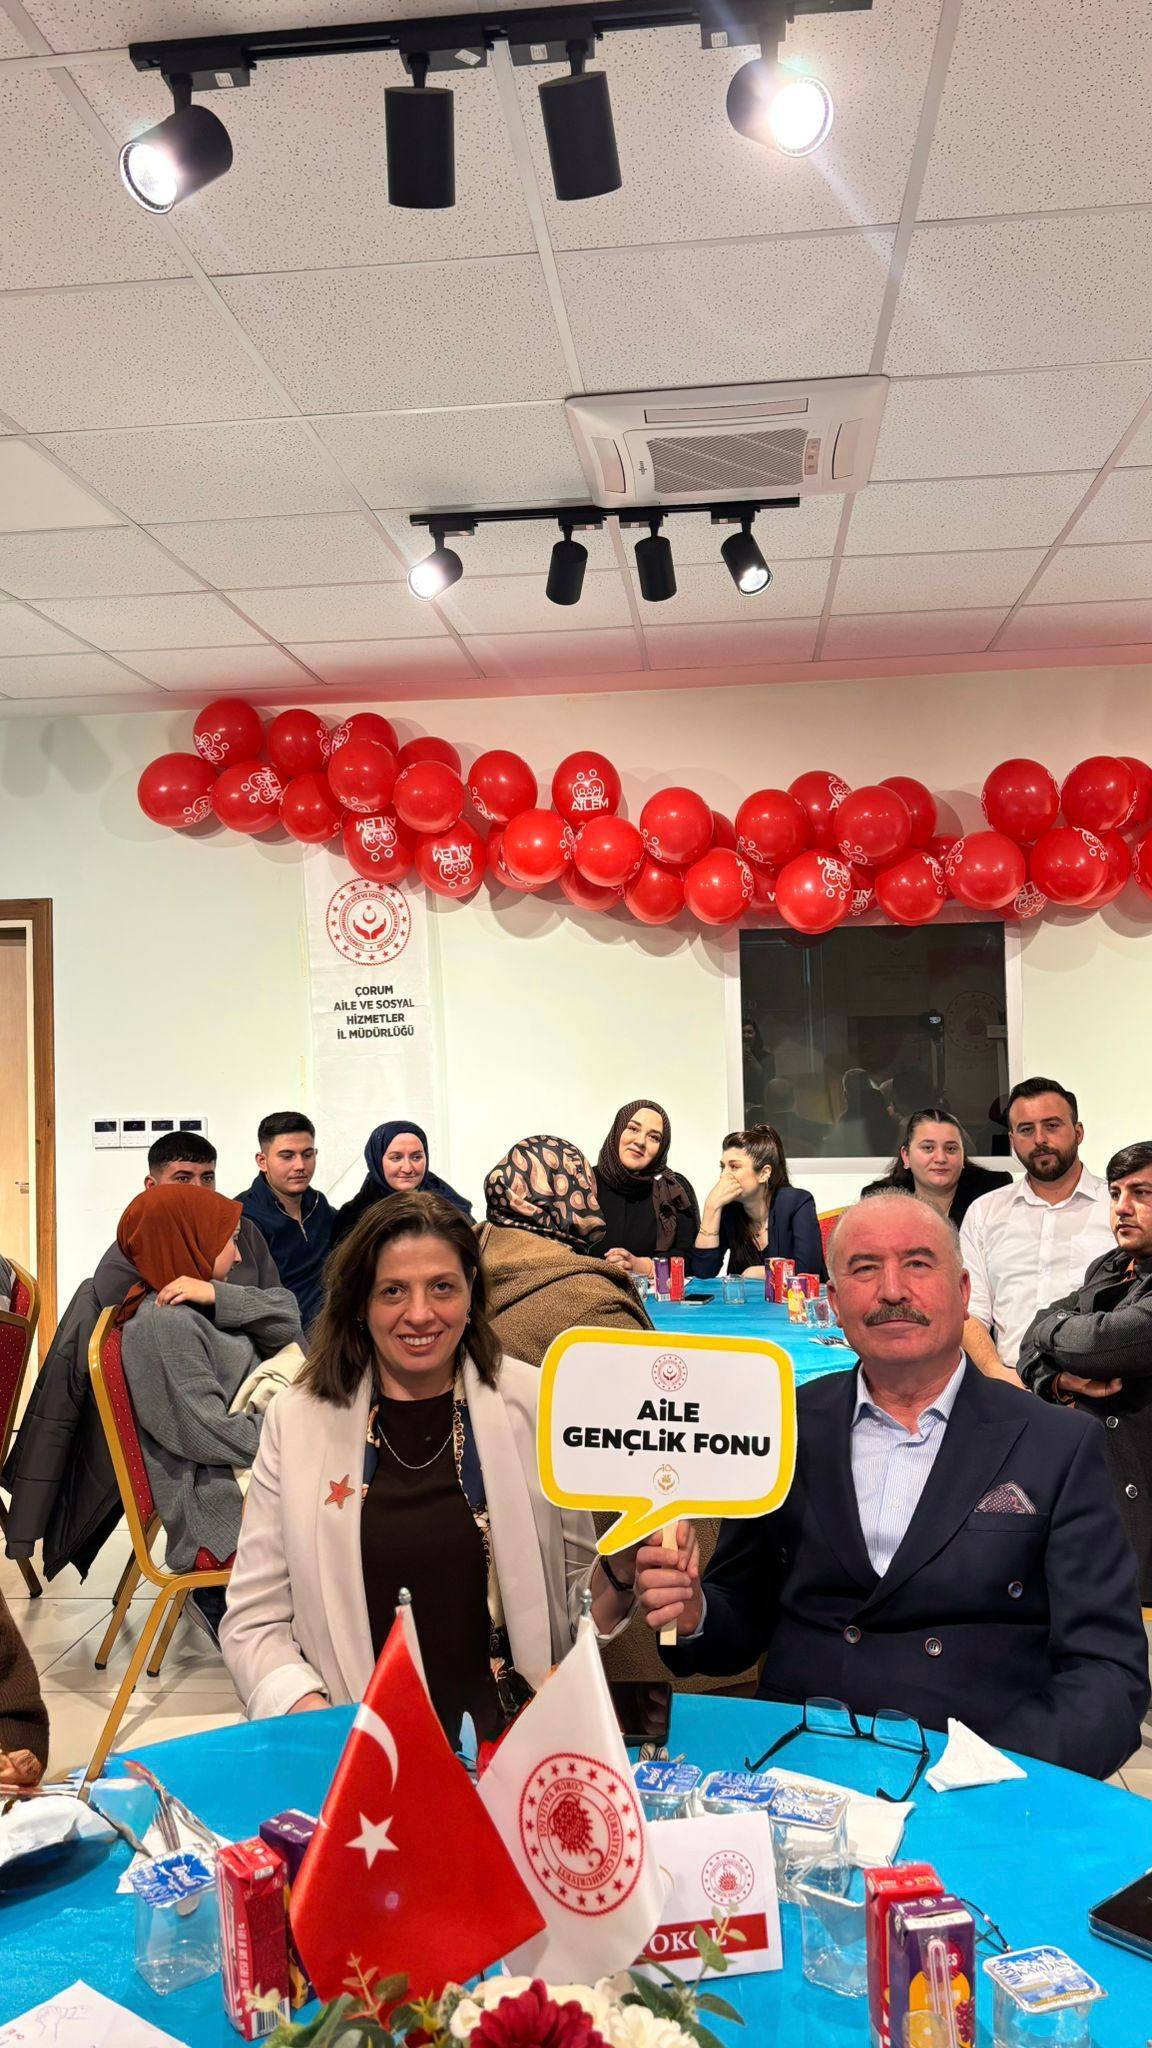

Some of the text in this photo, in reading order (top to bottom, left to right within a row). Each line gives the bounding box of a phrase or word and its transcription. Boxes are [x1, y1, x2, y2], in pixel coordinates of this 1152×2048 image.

[355, 985, 394, 997] ÇORUM
[334, 998, 415, 1011] AİLE VE SOSYAL
[347, 1013, 405, 1025] HİZMETLER
[337, 1025, 415, 1039] İL MÜDÜRLÜĞÜ
[693, 1433, 771, 1457] FONU
